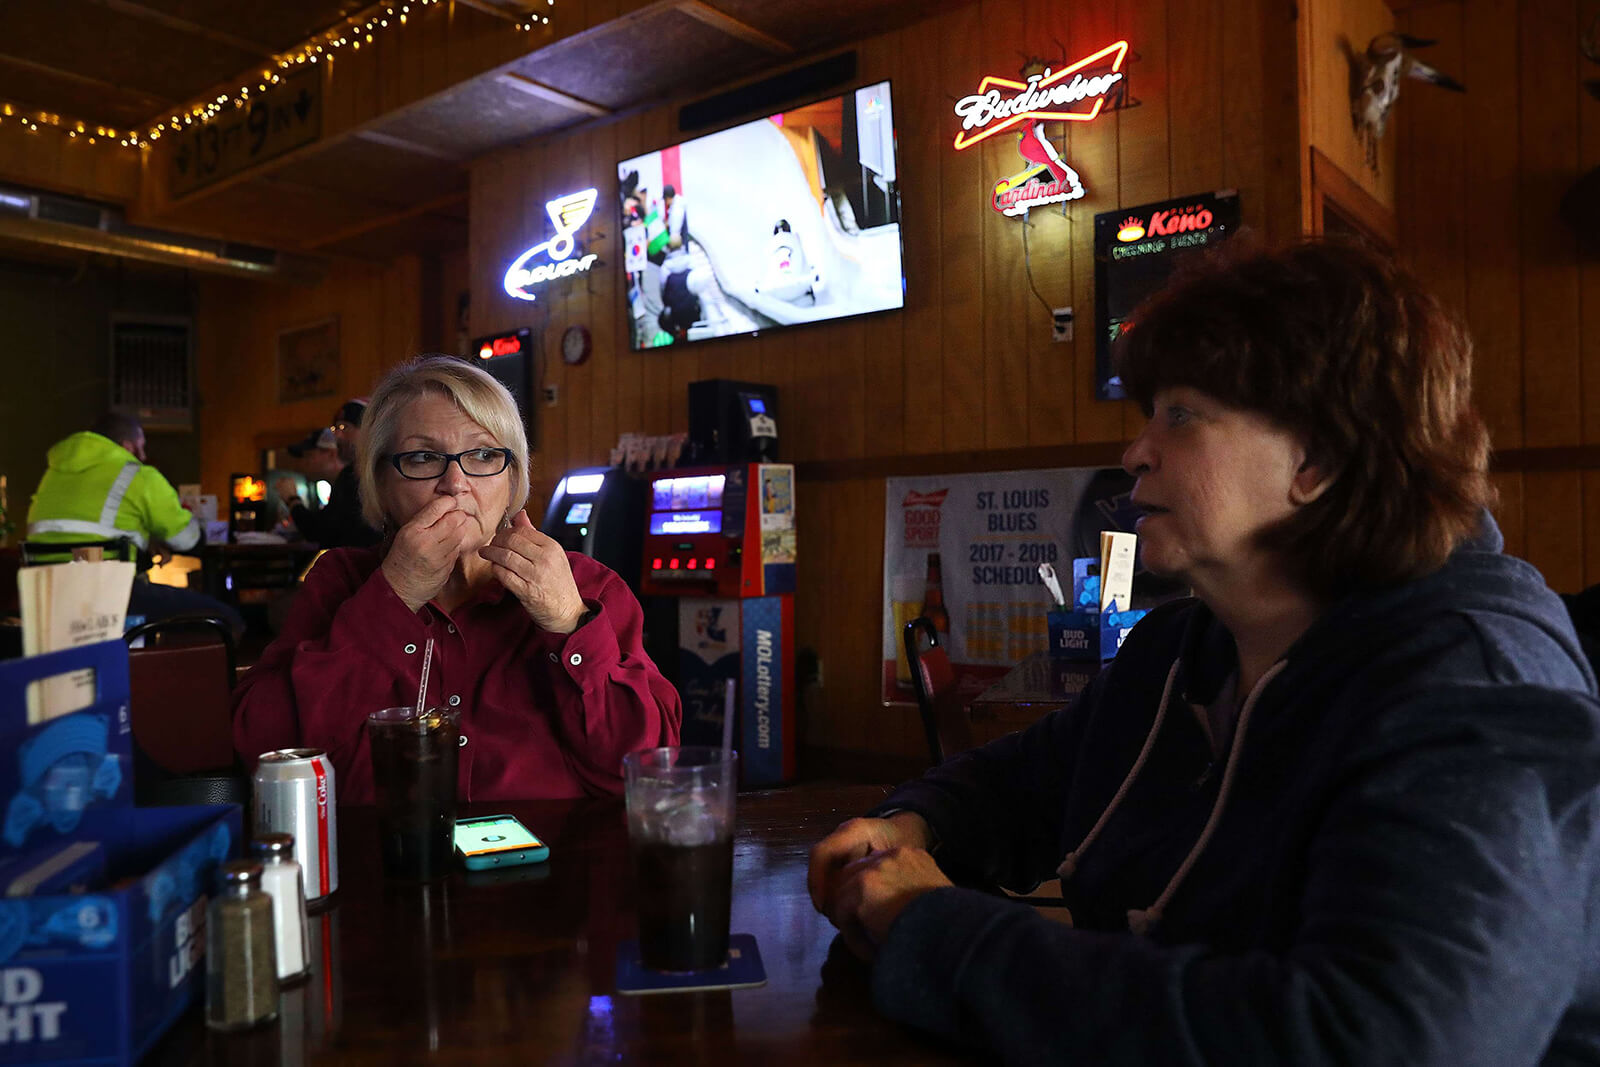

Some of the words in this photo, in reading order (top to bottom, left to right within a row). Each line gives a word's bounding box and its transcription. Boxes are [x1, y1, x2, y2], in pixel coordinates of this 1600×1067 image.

[954, 72, 1122, 130] Budweiser
[249, 101, 267, 156] 9
[1147, 208, 1213, 238] Keno
[976, 491, 998, 510] ST.
[1003, 489, 1049, 509] LOUIS
[988, 512, 1037, 532] BLUES
[969, 543, 1005, 562] 2017
[1018, 543, 1058, 562] 2018
[1060, 638, 1089, 649] LIGHT
[1063, 629, 1086, 639] BUD
